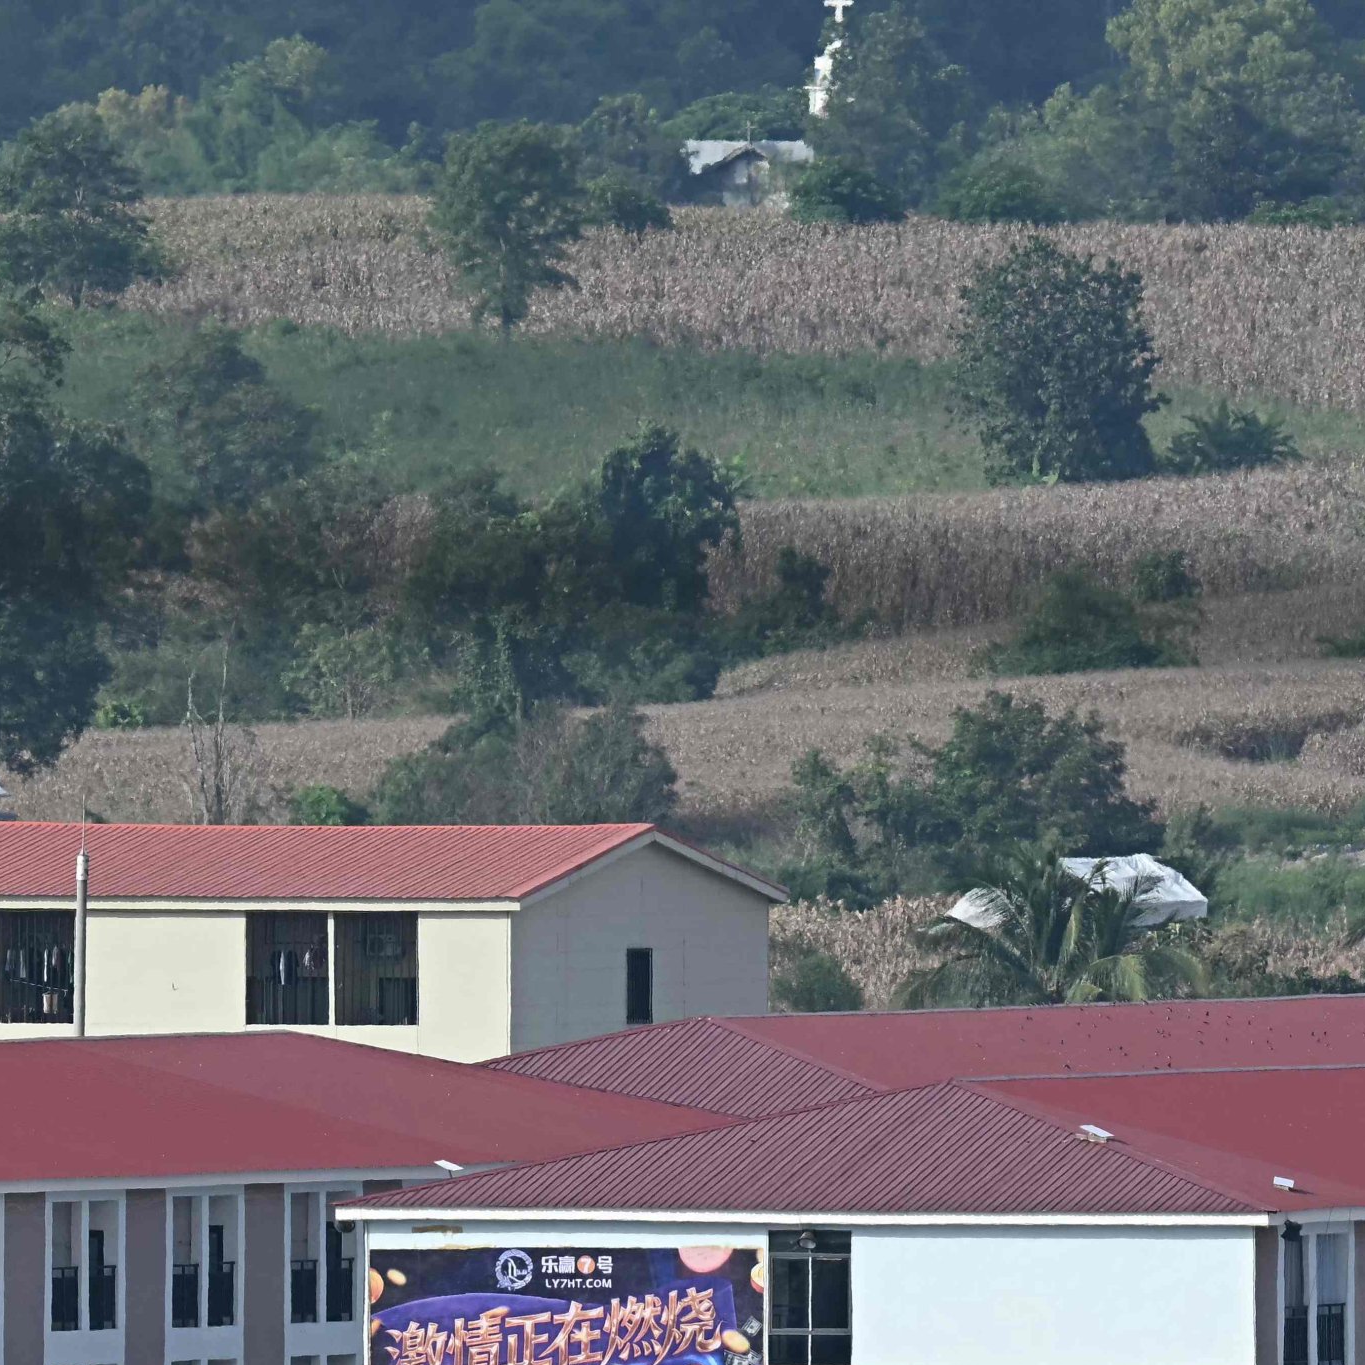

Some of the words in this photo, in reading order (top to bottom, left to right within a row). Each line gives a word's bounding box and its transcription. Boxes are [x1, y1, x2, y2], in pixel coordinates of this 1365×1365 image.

[541, 1255, 613, 1274] 乐赢7号
[545, 1279, 612, 1288] LY7HT.COM
